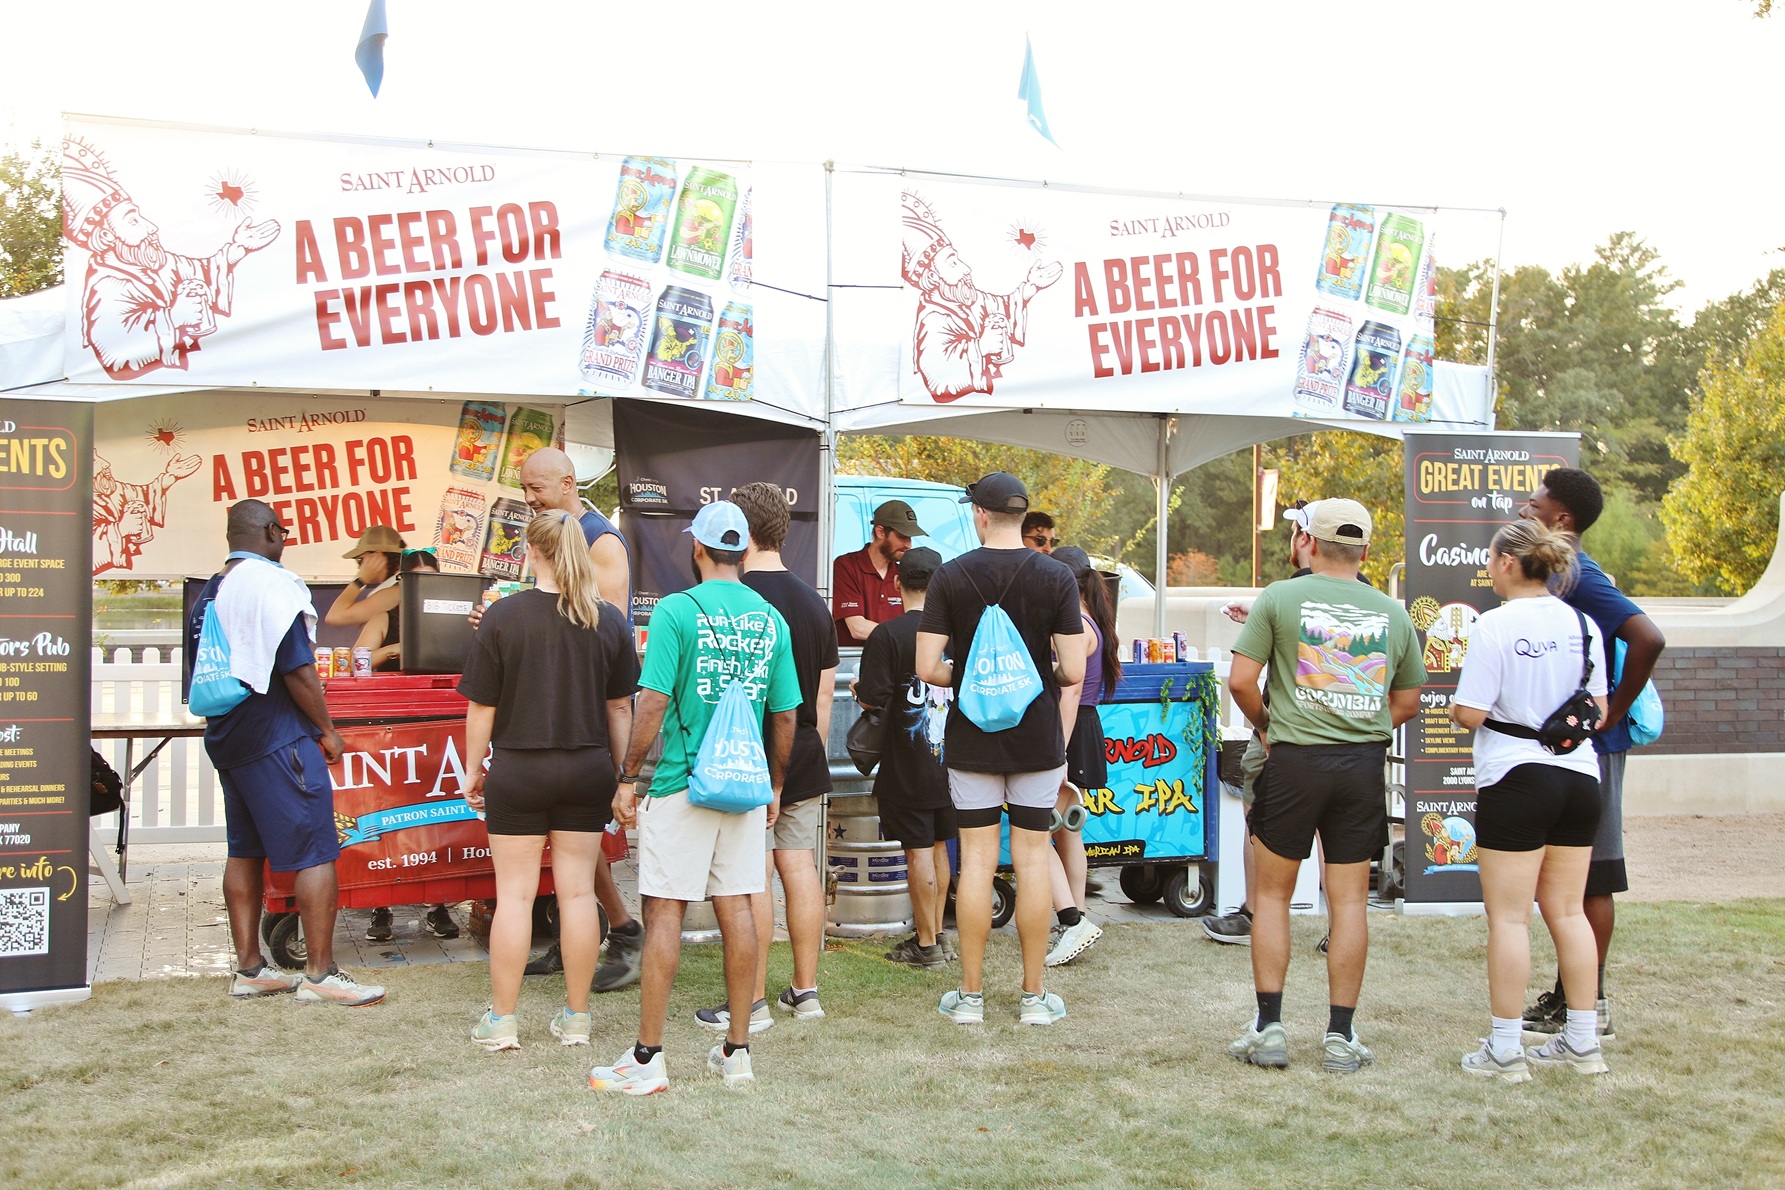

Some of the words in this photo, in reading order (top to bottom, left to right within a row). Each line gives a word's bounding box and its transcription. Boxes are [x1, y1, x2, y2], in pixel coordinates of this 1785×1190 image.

[340, 170, 404, 192] SAINT
[406, 165, 495, 195] ARNOLD
[684, 181, 706, 194] SAINT
[704, 185, 736, 200] ARNOLD
[1110, 218, 1158, 236] SAINT
[1160, 212, 1230, 238] ARNOLD
[295, 220, 325, 284] A
[334, 207, 463, 277] BEER
[469, 201, 562, 270] FOR
[670, 245, 722, 270] LAWNMOWER
[1074, 262, 1098, 318] A
[1104, 252, 1203, 314] BEER
[1209, 244, 1282, 303] FOR
[314, 268, 561, 351] EVERYONE
[658, 300, 682, 312] SAINT
[680, 304, 712, 320] ARNOLD
[1088, 305, 1279, 378] EVERYONE
[584, 349, 612, 367] GRAND
[612, 357, 636, 374] PRIZE
[684, 375, 696, 390] IPA
[247, 416, 296, 434] SAINT
[297, 409, 366, 432] ARNOLD
[1454, 448, 1486, 460] SAINT
[1484, 448, 1530, 464] ARNOLD
[213, 454, 237, 502] A
[242, 444, 340, 498] BEER
[346, 435, 418, 486] FOR
[1420, 460, 1482, 494] GREAT
[1488, 464, 1562, 493] EVENT
[630, 483, 667, 496] HOUSTON
[1471, 496, 1487, 508] on
[1486, 490, 1513, 514] tap
[227, 486, 416, 547] ERYONE
[491, 508, 508, 516] SAINT
[437, 548, 455, 560] RAND
[14, 559, 39, 568] EVENT
[40, 560, 65, 568] SPACE
[5, 573, 20, 582] 300
[1478, 579, 1494, 587] SAINT
[4, 588, 16, 597] UP
[16, 588, 27, 597] TO
[28, 588, 44, 597] 224
[632, 596, 660, 606] OUSTO
[32, 632, 70, 656] Pub
[36, 662, 68, 672] SETTING
[4, 678, 20, 686] 100
[696, 678, 712, 695] a
[718, 674, 768, 701] Sar
[1018, 677, 1032, 688] 5K
[3, 692, 14, 700] UP
[16, 692, 26, 700] TO
[26, 692, 38, 700] 60
[1420, 691, 1446, 708] enjoy
[4, 748, 34, 756] MEETINGS
[1104, 732, 1178, 769] RNOLD
[15, 760, 37, 768] EVENTS
[1450, 767, 1466, 775] SAINT
[40, 784, 65, 792] DINNERS
[1443, 776, 1458, 784] 2000
[46, 796, 64, 804] MORE!
[1134, 778, 1199, 817] IPA
[382, 809, 430, 826] PATRON
[430, 804, 466, 818] SAINT
[1416, 801, 1448, 812] SAINT
[1447, 800, 1478, 815] ARNO
[5, 834, 30, 844] 77020
[1085, 845, 1121, 858] MERICAN
[1122, 845, 1140, 856] IPA
[20, 856, 52, 880] info
[368, 857, 397, 870] est.
[401, 851, 438, 868] 1994
